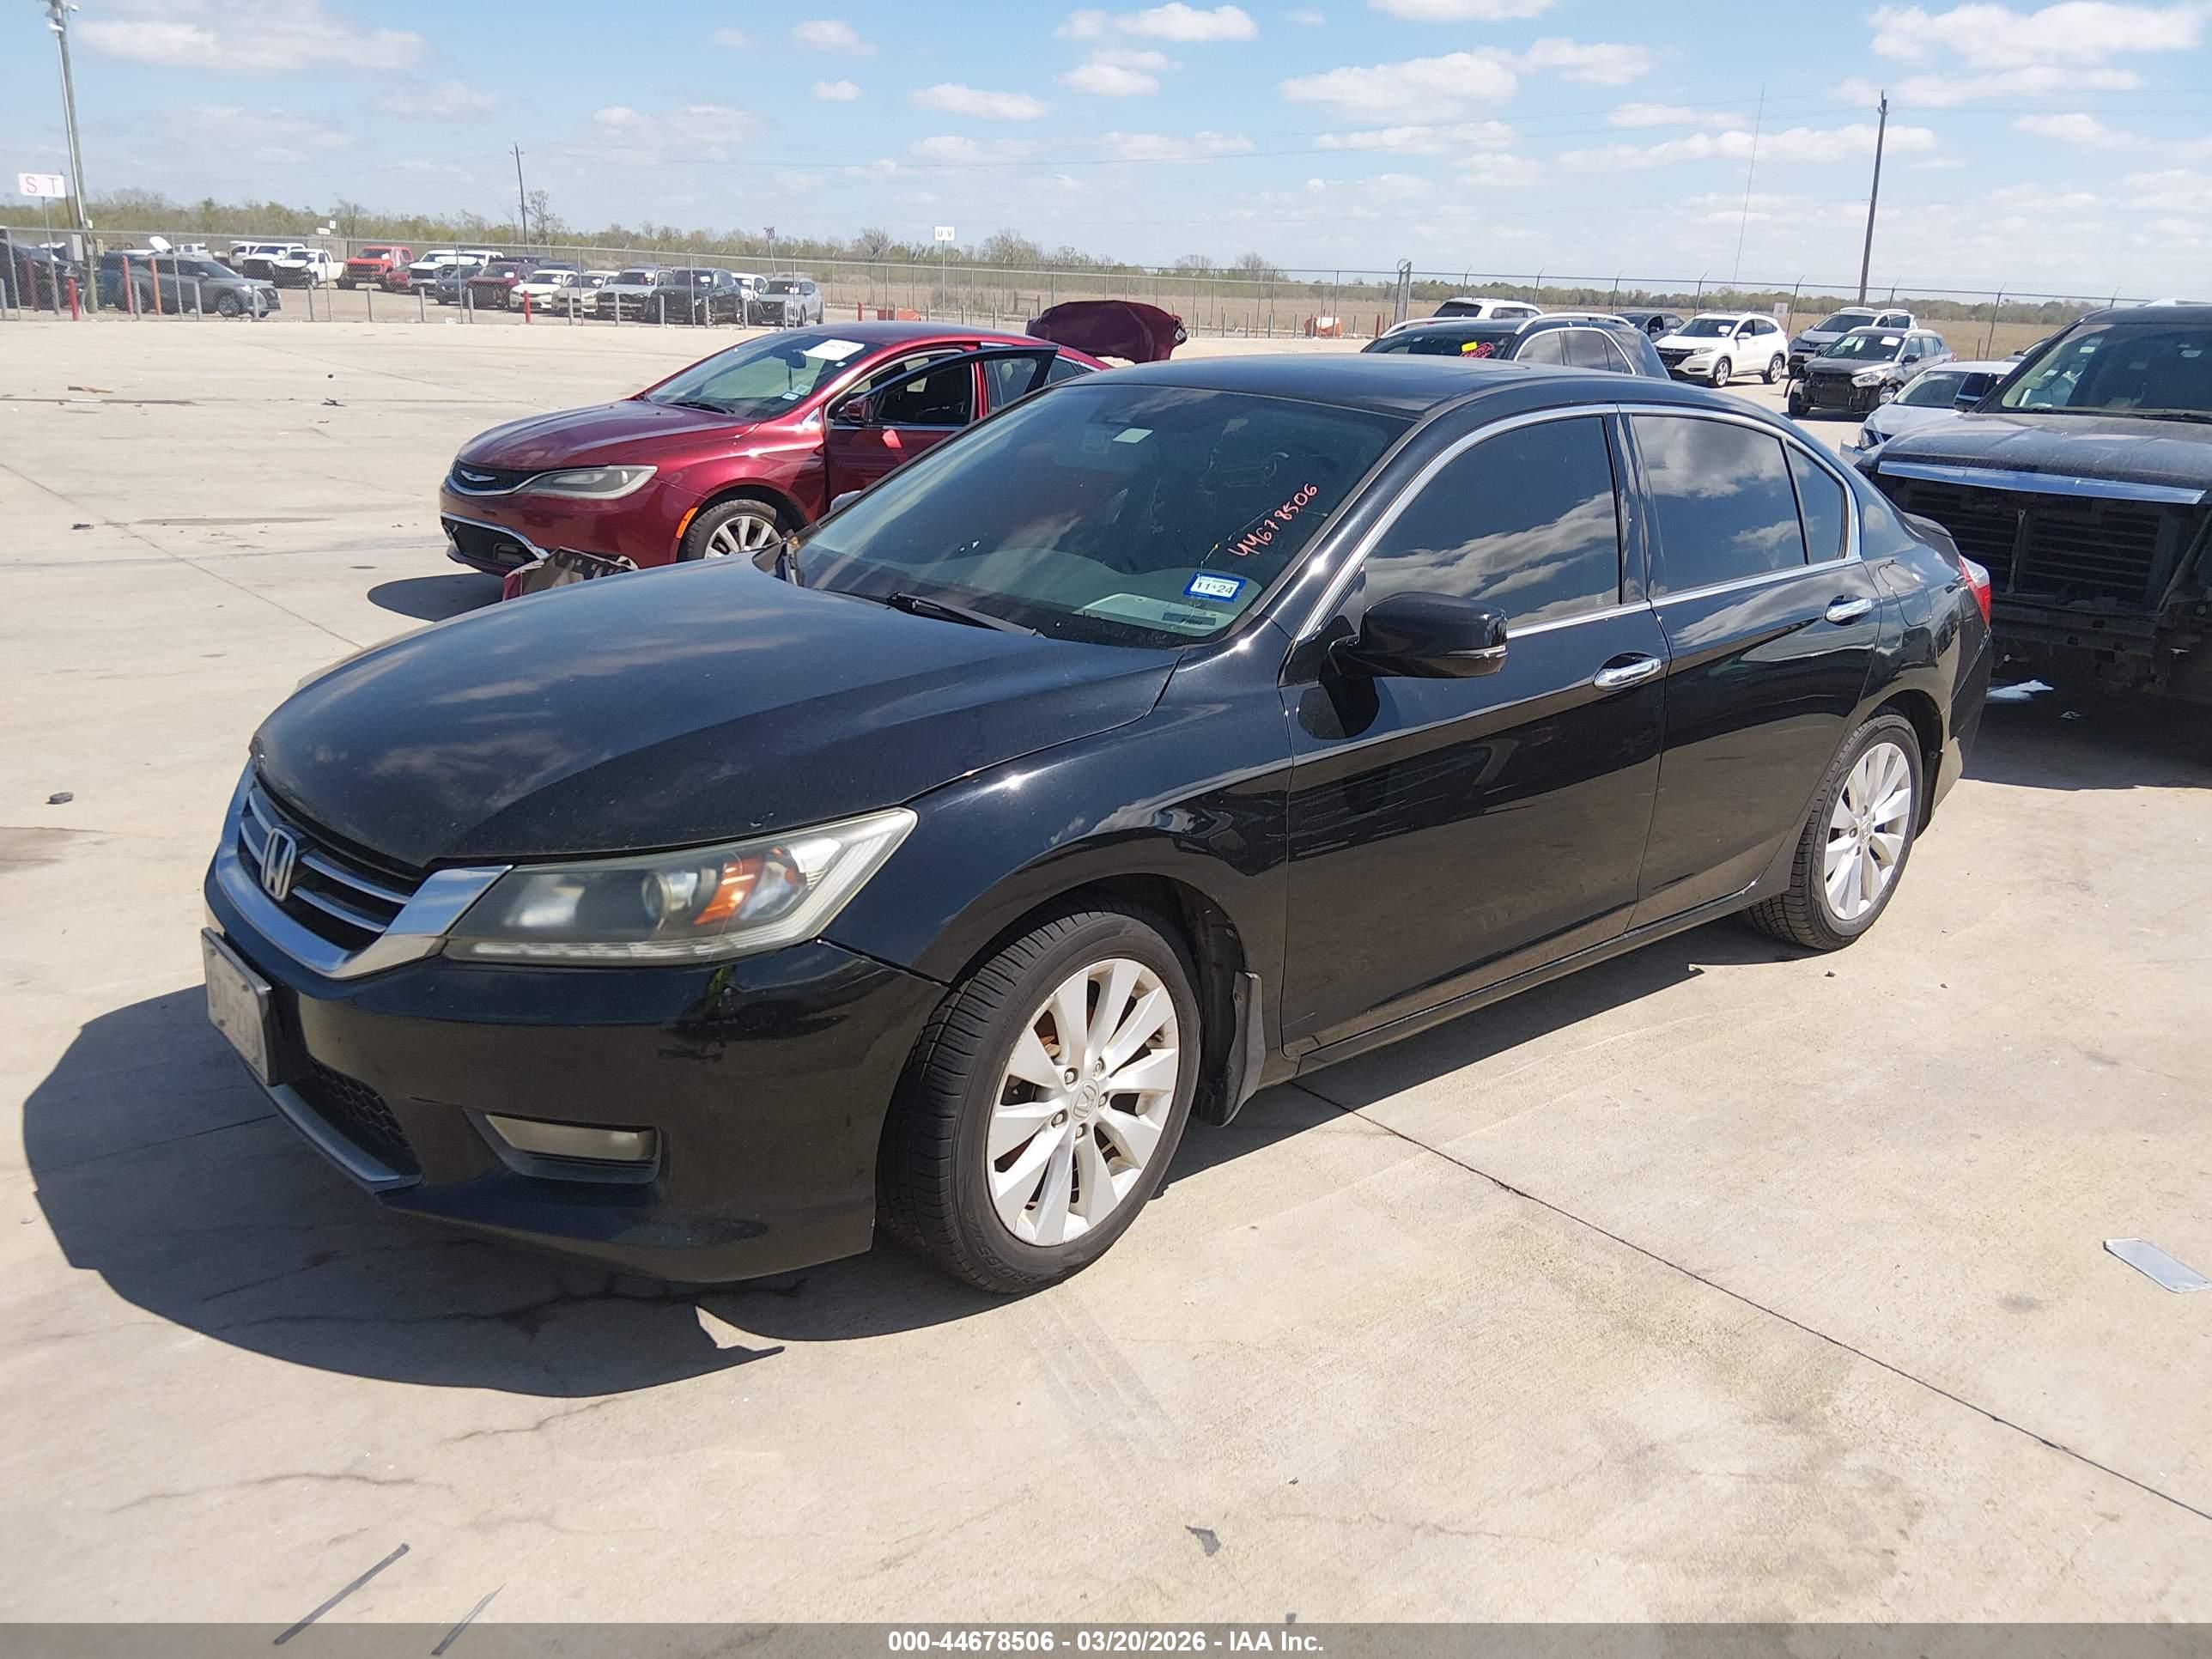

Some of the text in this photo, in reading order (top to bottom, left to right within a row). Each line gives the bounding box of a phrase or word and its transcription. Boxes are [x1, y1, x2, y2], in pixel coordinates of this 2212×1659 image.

[26, 176, 58, 195] S T
[1227, 483, 1318, 557] 44678506
